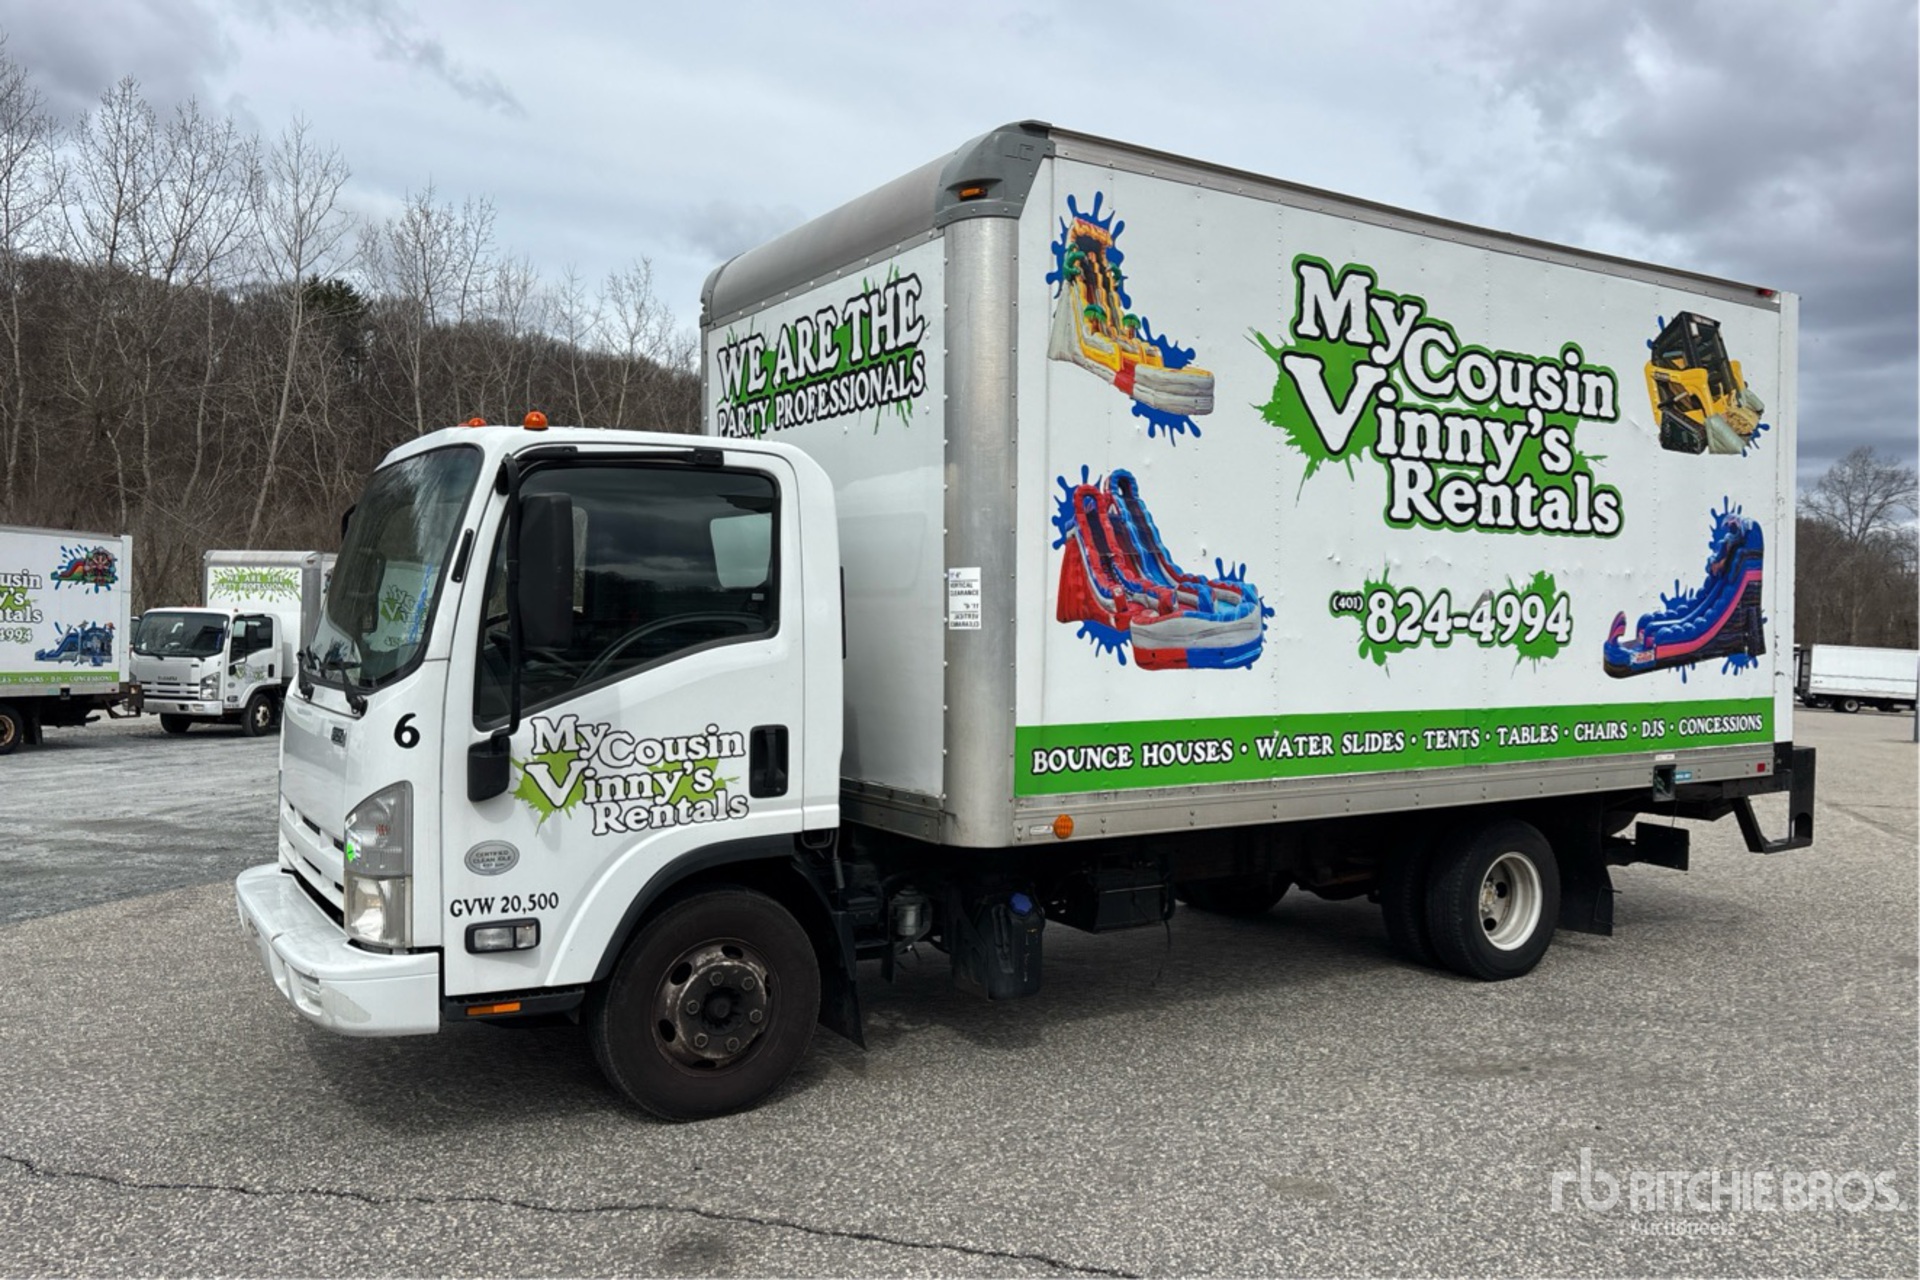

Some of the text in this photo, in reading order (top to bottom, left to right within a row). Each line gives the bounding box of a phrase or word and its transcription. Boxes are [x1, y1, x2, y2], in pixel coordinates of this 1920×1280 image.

[717, 273, 926, 403] WE ARE THE
[1295, 258, 1617, 421] My Cousin
[717, 350, 926, 438] PARTY PROFESSIONALS
[1281, 350, 1574, 484] Vinny's
[1388, 456, 1622, 536] Rentals
[1331, 588, 1572, 646] (401) 824-4994
[394, 712, 420, 749] 6
[530, 714, 746, 768] My Cousin
[1031, 713, 1763, 775] BOUNCE HOUSES WATER SLIDES TENTS TABLES CHAIRS DJS CONCESSIONS
[524, 758, 716, 808] Vinny's
[592, 789, 750, 836] Rentals
[450, 891, 560, 918] GVW 20,500
